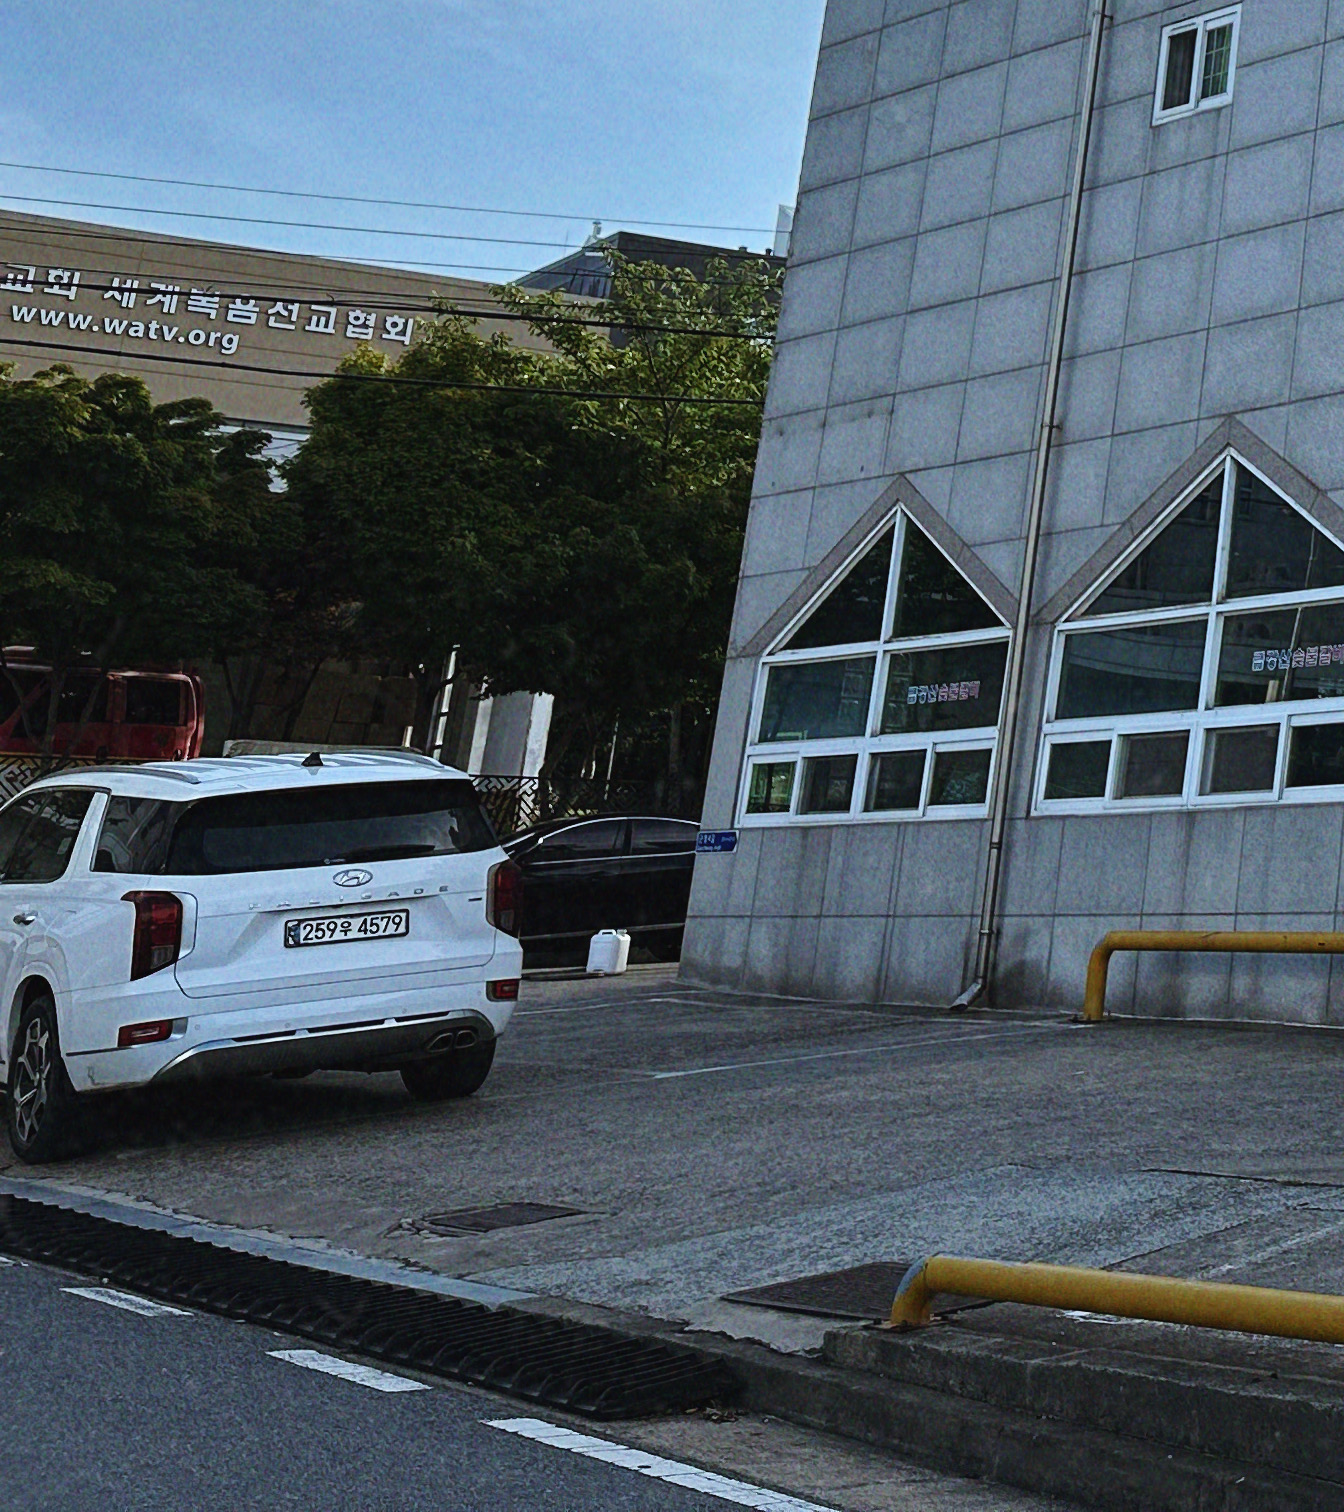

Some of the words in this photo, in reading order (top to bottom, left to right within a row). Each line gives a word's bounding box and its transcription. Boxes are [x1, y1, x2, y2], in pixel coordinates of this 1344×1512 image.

[0, 264, 81, 300] 교회
[103, 275, 415, 346] 세계복음선교협회
[11, 303, 241, 355] www.watv.org
[302, 919, 353, 942] 259우
[357, 914, 403, 936] 4579
